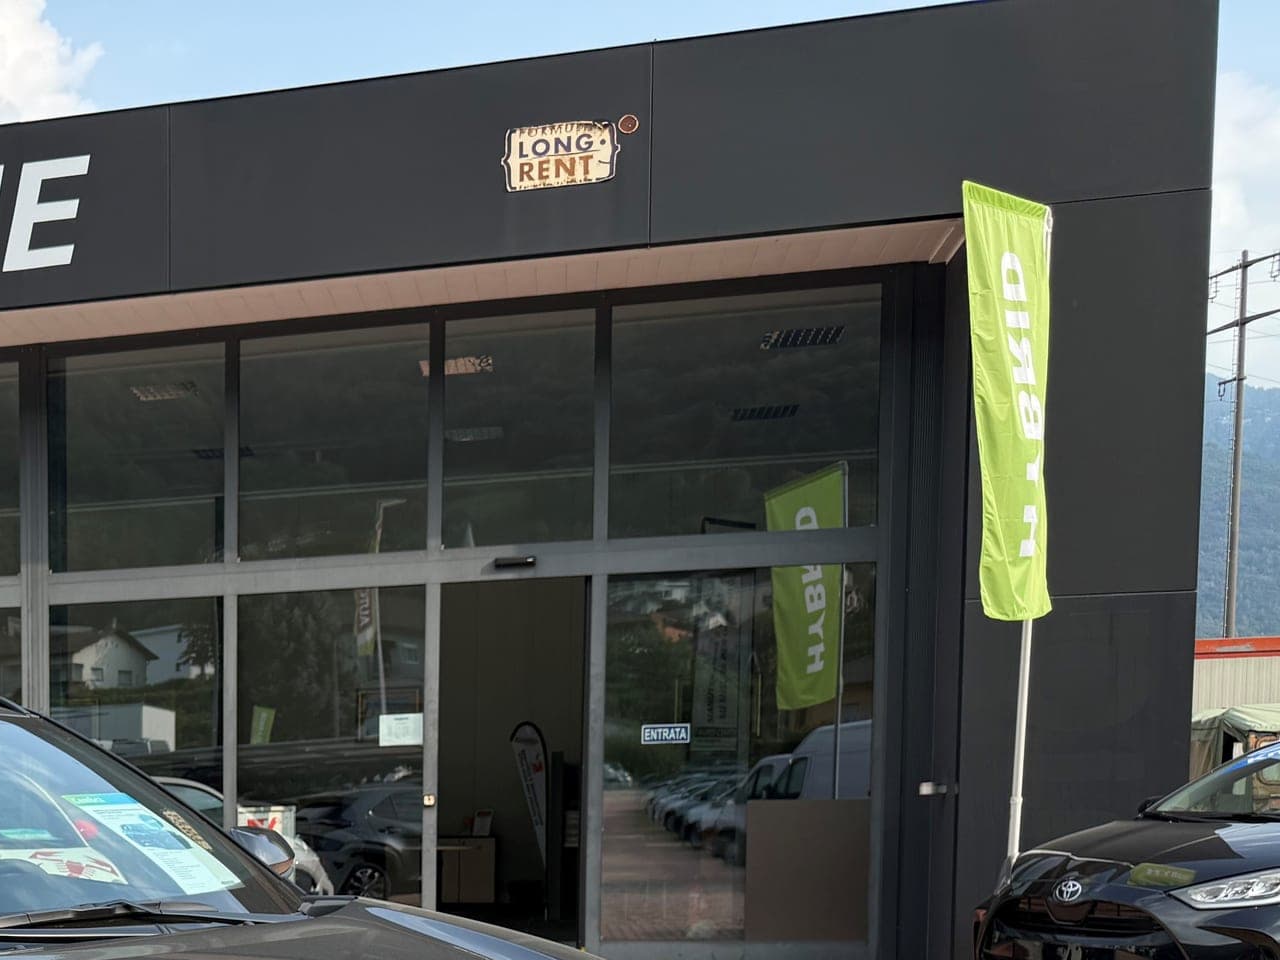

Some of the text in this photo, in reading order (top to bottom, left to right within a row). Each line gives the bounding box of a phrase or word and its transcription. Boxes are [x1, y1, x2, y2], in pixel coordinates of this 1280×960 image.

[519, 133, 594, 159] LONG
[519, 154, 594, 183] RENT
[644, 727, 687, 742] ENTRATA
